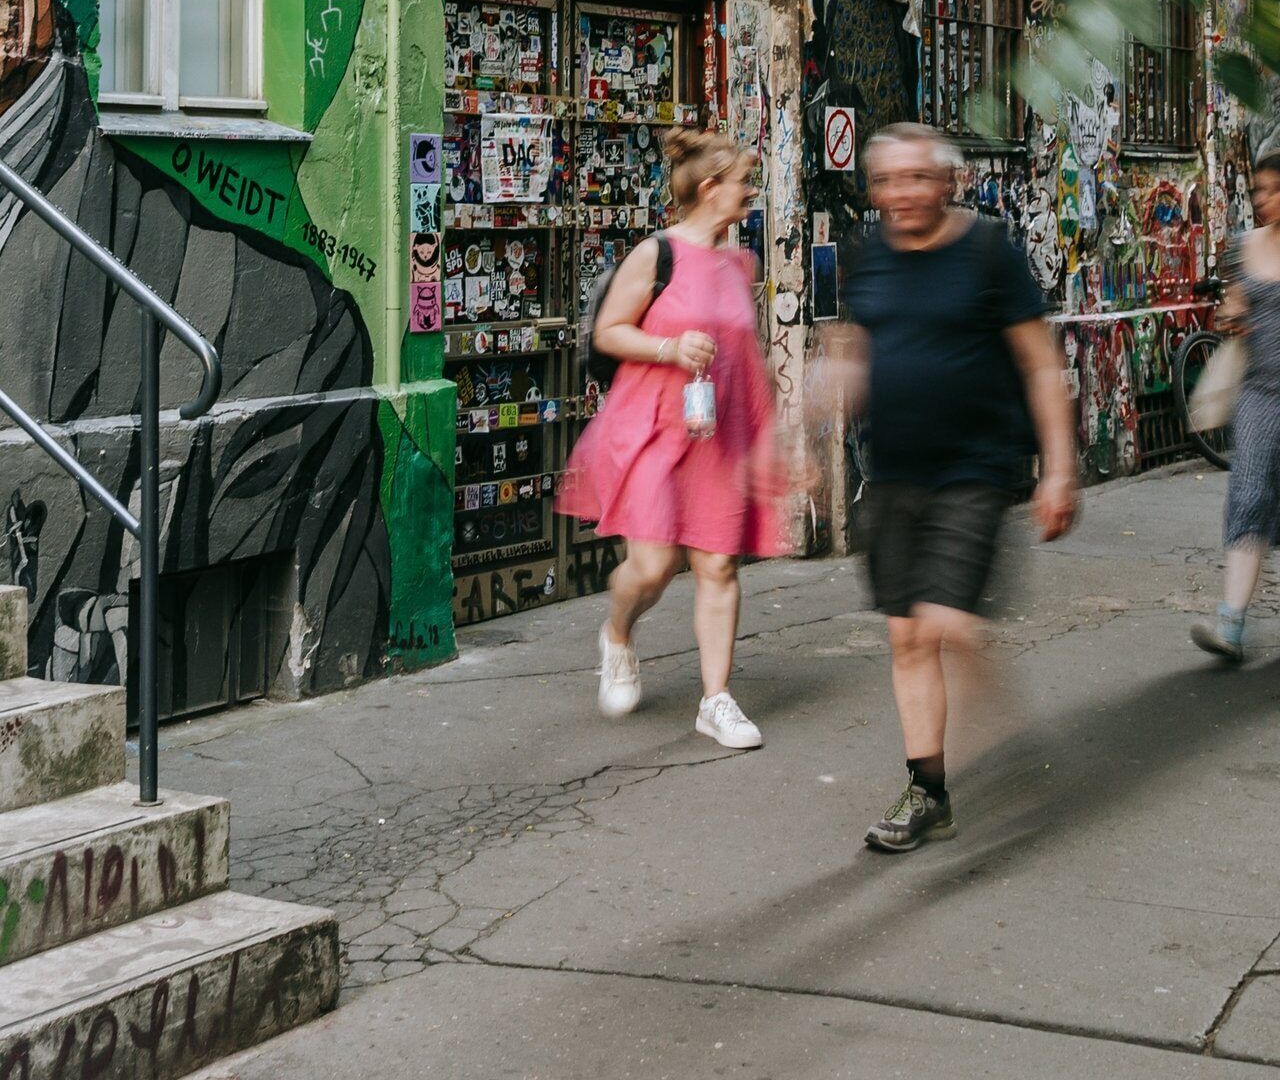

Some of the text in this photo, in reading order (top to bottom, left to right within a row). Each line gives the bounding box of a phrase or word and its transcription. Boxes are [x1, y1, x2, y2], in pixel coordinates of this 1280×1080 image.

[196, 149, 285, 223] WEIDT
[301, 222, 377, 282] 1883-1947
[445, 248, 462, 263] LOL
[446, 258, 463, 273] SPD
